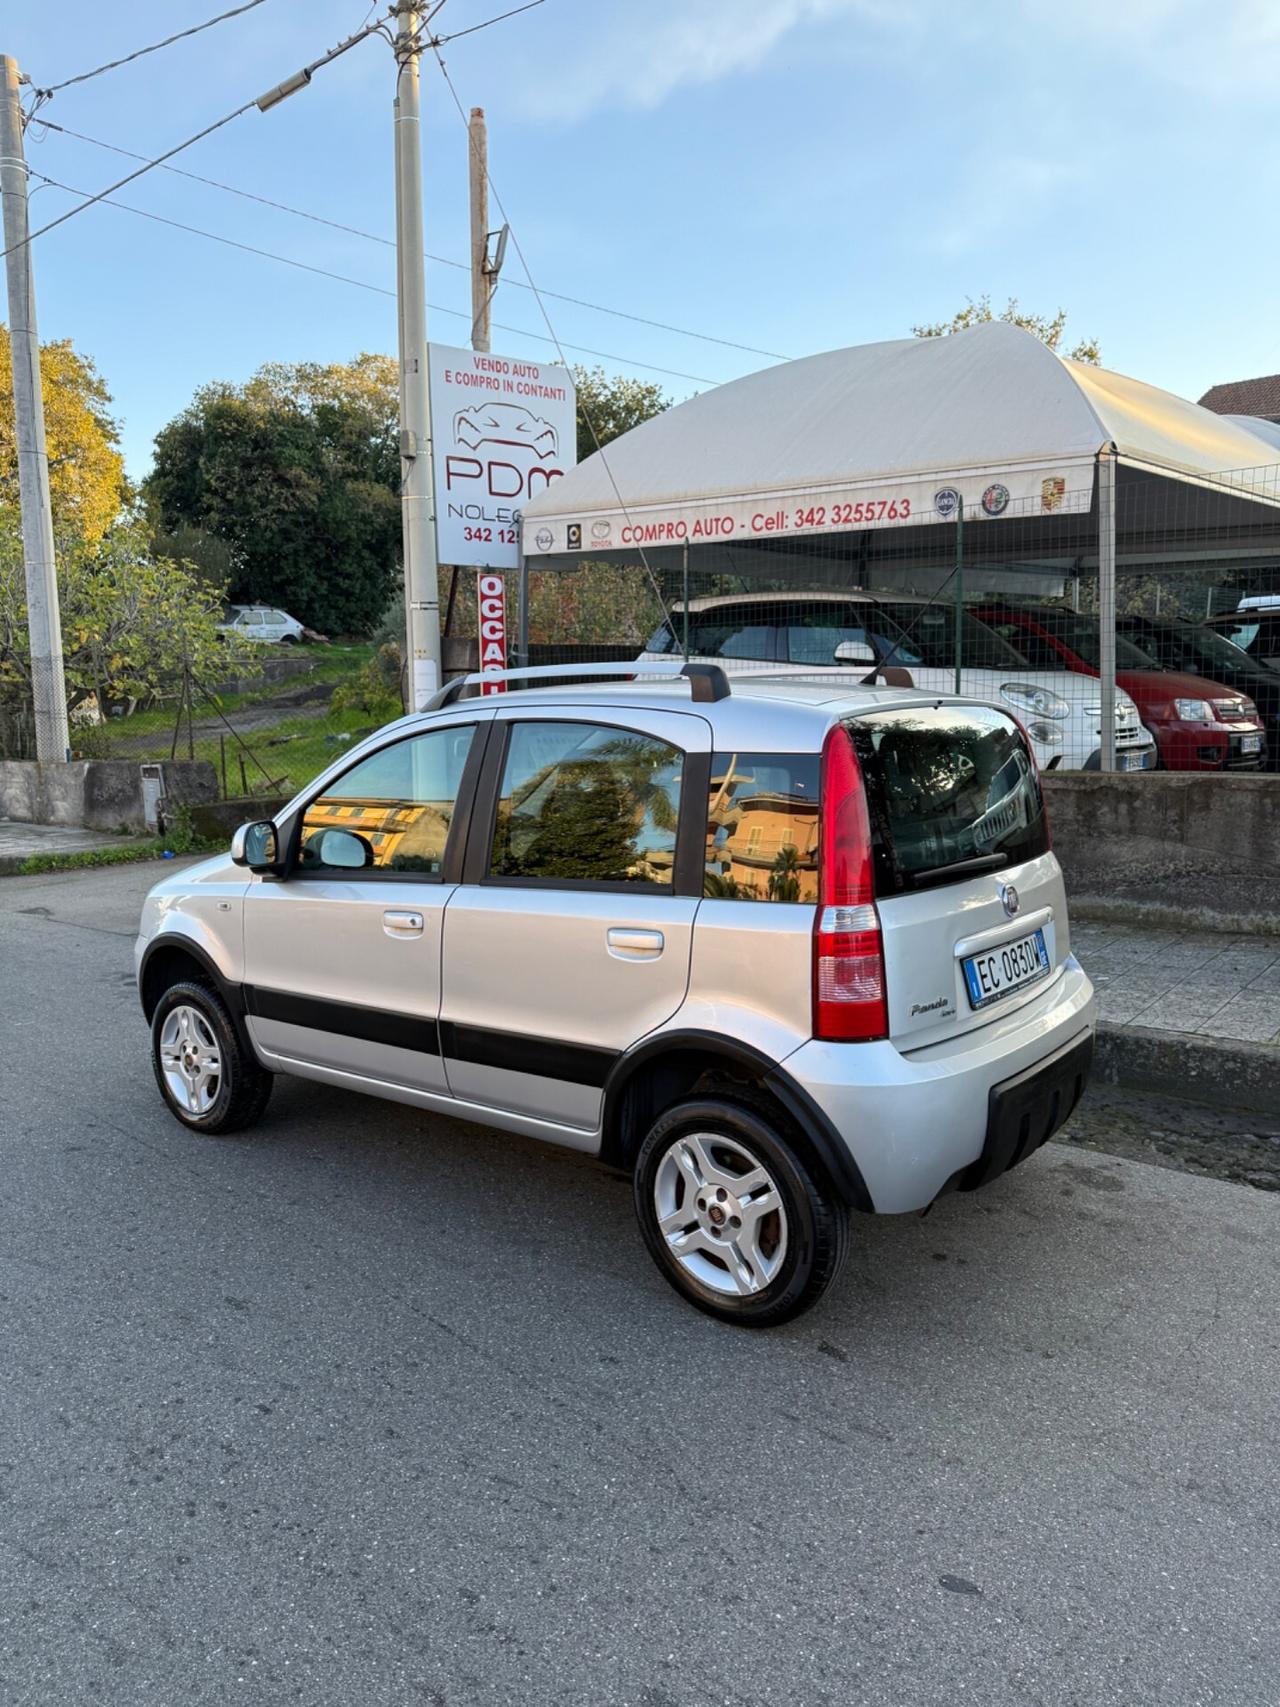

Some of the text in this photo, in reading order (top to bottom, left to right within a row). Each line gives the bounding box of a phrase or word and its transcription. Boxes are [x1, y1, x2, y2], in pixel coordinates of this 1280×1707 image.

[473, 357, 539, 379] VENDO AUTO
[445, 370, 566, 401] E COMPRO IN CONTANTI
[464, 526, 492, 543] 342
[498, 529, 519, 543] 12
[621, 521, 687, 543] COMPRO
[692, 516, 734, 536] AUTO
[751, 511, 789, 532] Cell:
[794, 507, 826, 528] 342
[831, 499, 910, 524] 3255763
[977, 956, 1000, 993] EC
